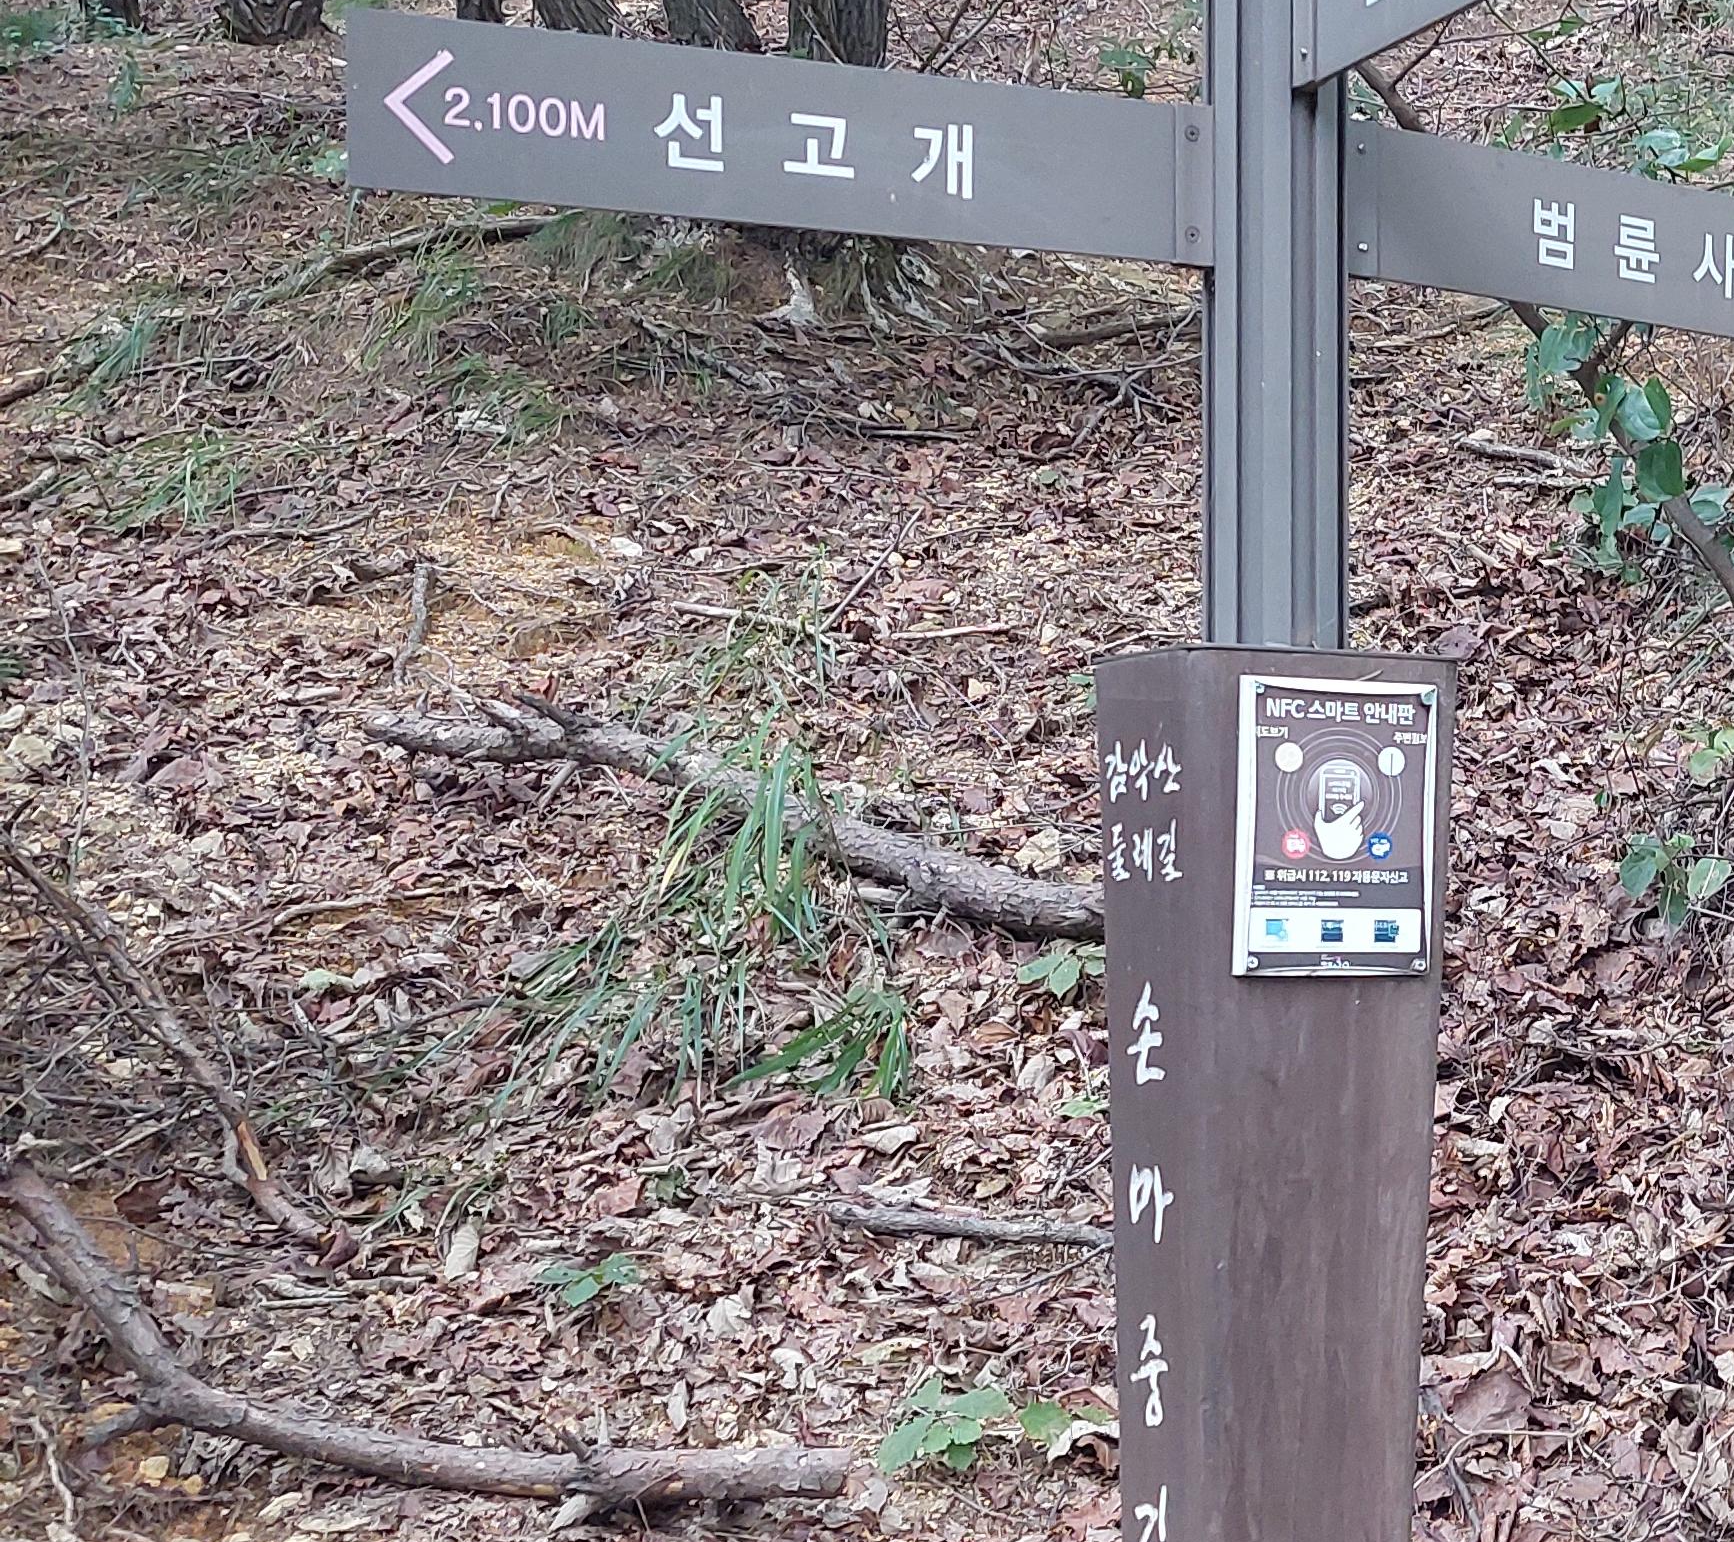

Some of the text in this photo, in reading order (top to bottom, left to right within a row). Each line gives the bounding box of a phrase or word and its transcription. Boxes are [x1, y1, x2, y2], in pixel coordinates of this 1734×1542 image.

[1266, 697, 1417, 726] NFC 스마트 안내판
[1104, 738, 1183, 804] 감악산
[1106, 818, 1184, 882] 둘레길
